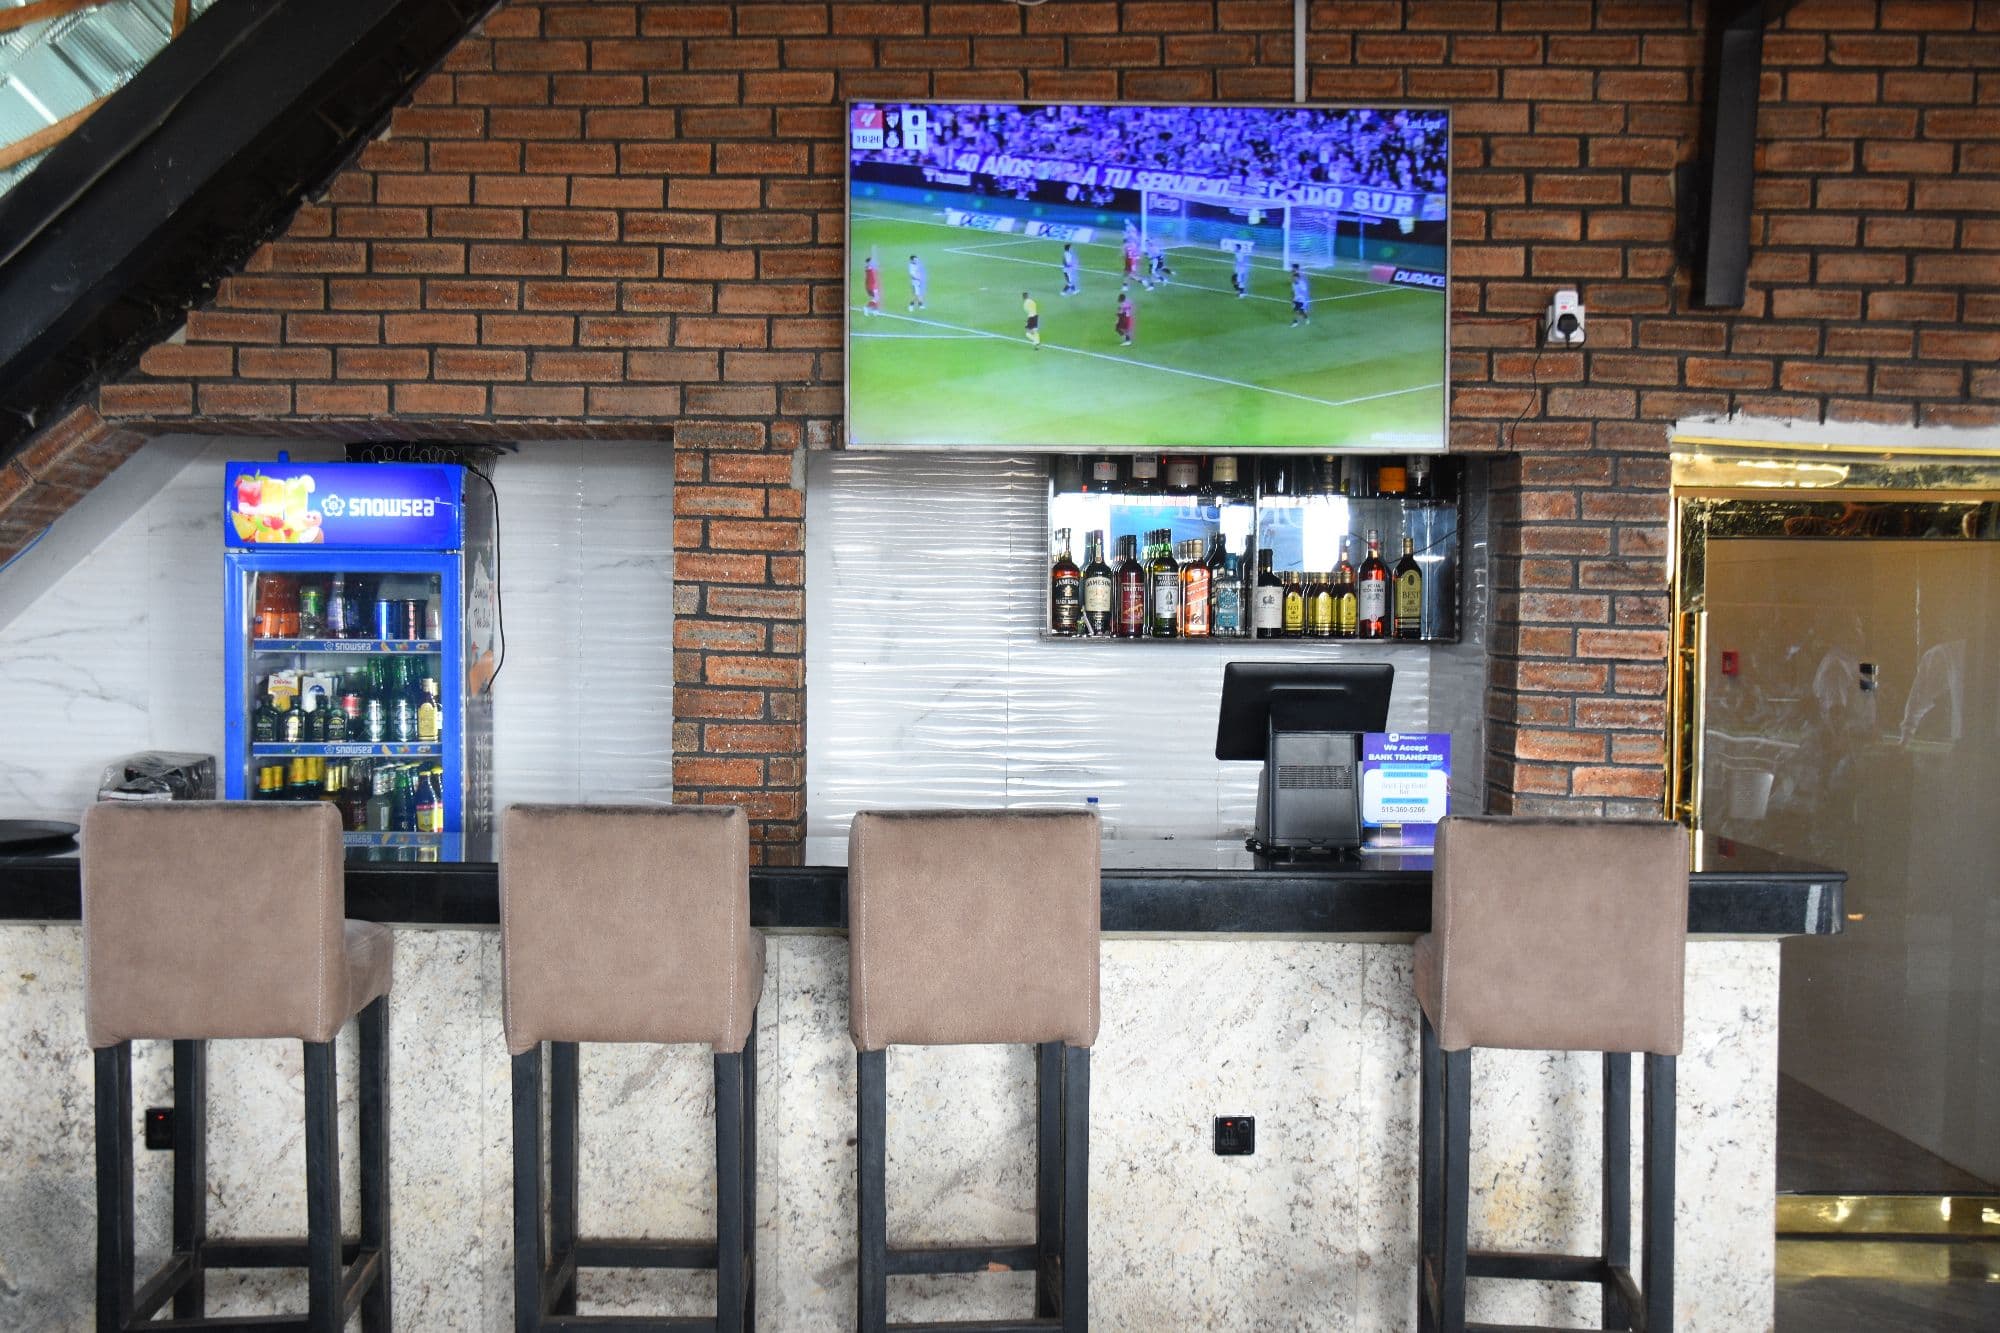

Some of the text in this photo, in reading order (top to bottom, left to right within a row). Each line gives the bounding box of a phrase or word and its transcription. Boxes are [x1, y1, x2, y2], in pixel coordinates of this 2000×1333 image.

[911, 114, 919, 126] 0
[913, 134, 918, 145] 1
[1353, 190, 1415, 215] SUR
[348, 498, 435, 517] snowsea
[1055, 579, 1079, 587] JAMESON
[1086, 579, 1112, 587] JAMESON
[1402, 591, 1419, 599] BEST
[335, 642, 372, 651] snowsea
[335, 745, 373, 754] snowsea
[1399, 744, 1429, 752] Accept
[1368, 753, 1444, 761] BANK TRANSFERS
